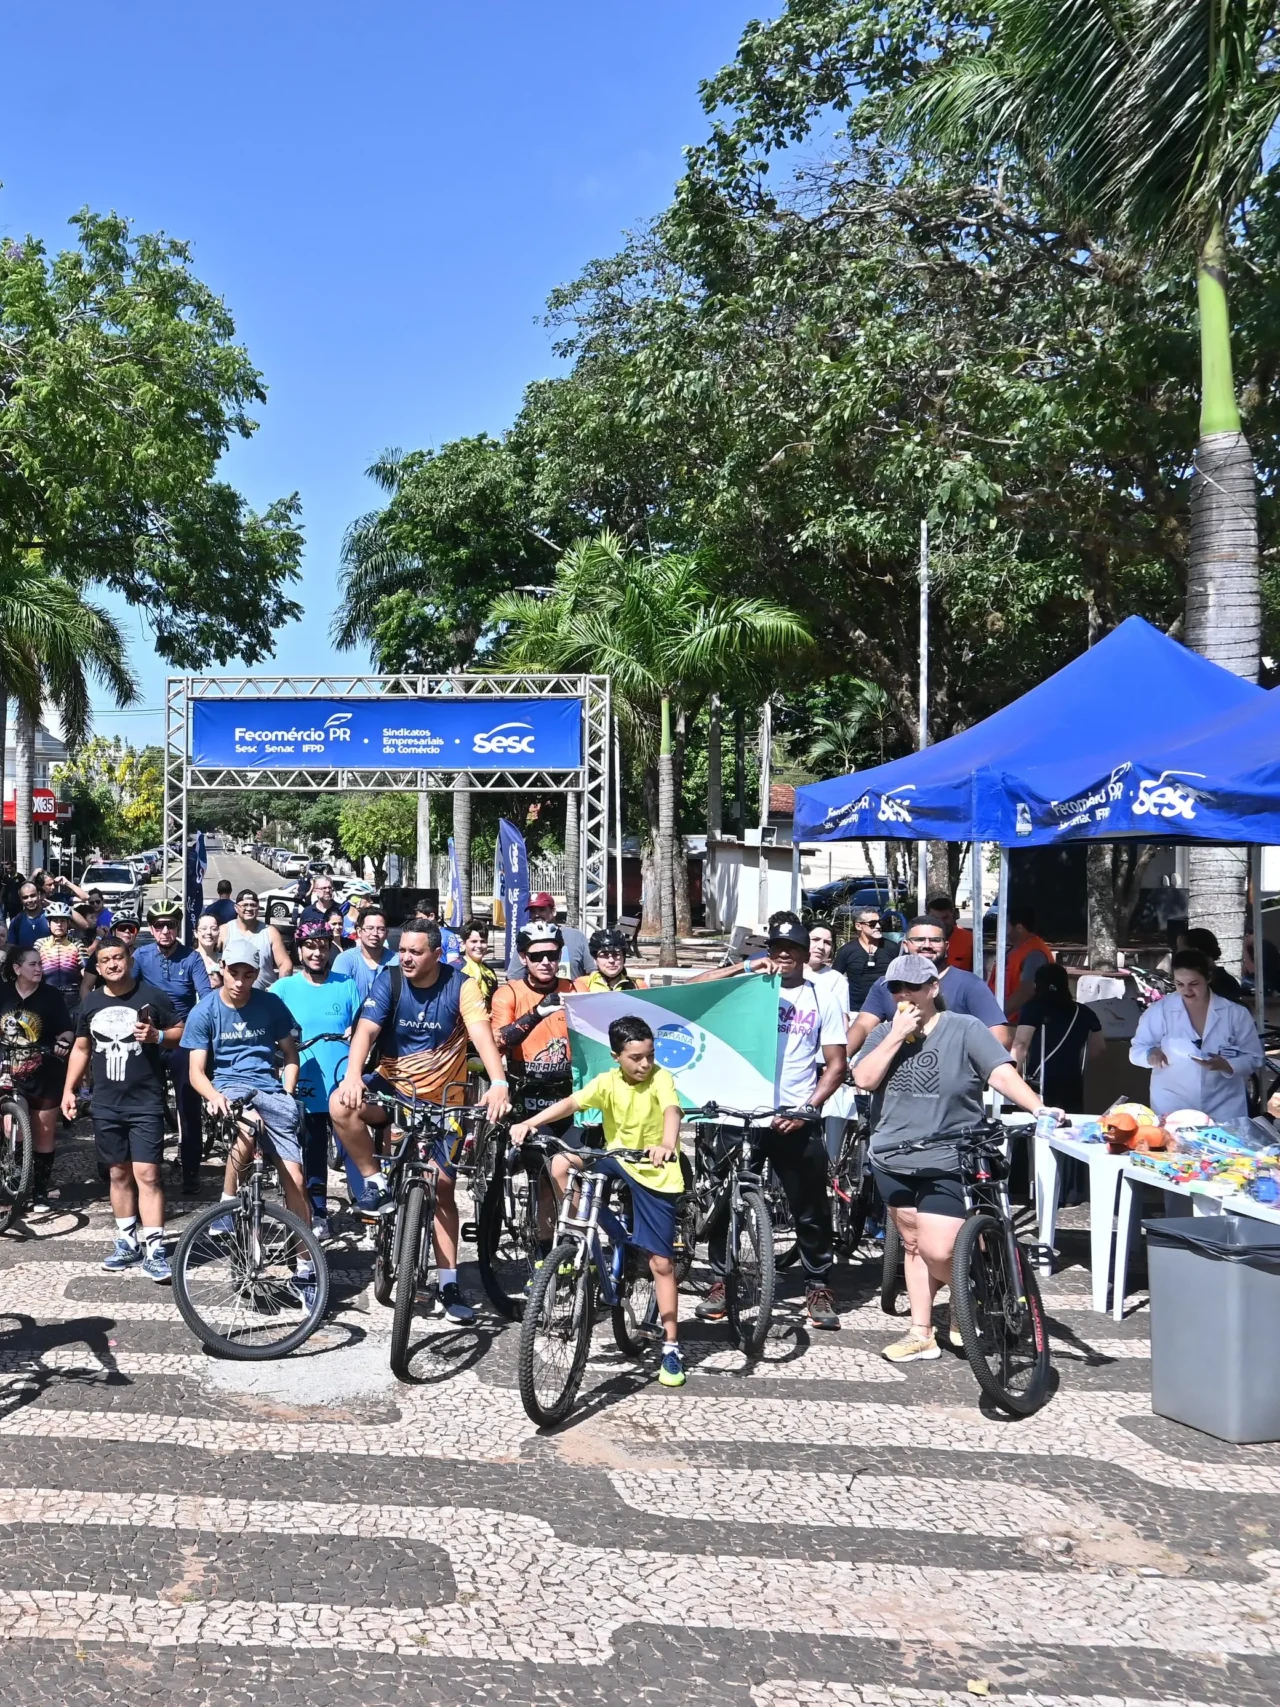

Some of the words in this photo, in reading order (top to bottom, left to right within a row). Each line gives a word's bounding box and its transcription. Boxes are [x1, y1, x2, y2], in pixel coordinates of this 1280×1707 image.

[234, 727, 325, 742] Fecomércio
[329, 727, 351, 741] PR
[382, 728, 431, 737] Sindicatos
[382, 736, 444, 746] Empresariais
[472, 722, 535, 754] Sesc
[235, 744, 257, 753] Sesc
[264, 744, 294, 753] Senac
[302, 744, 325, 753] IFPD
[382, 745, 396, 754] do
[397, 745, 440, 754] Comércio
[220, 1031, 243, 1040] RMANI
